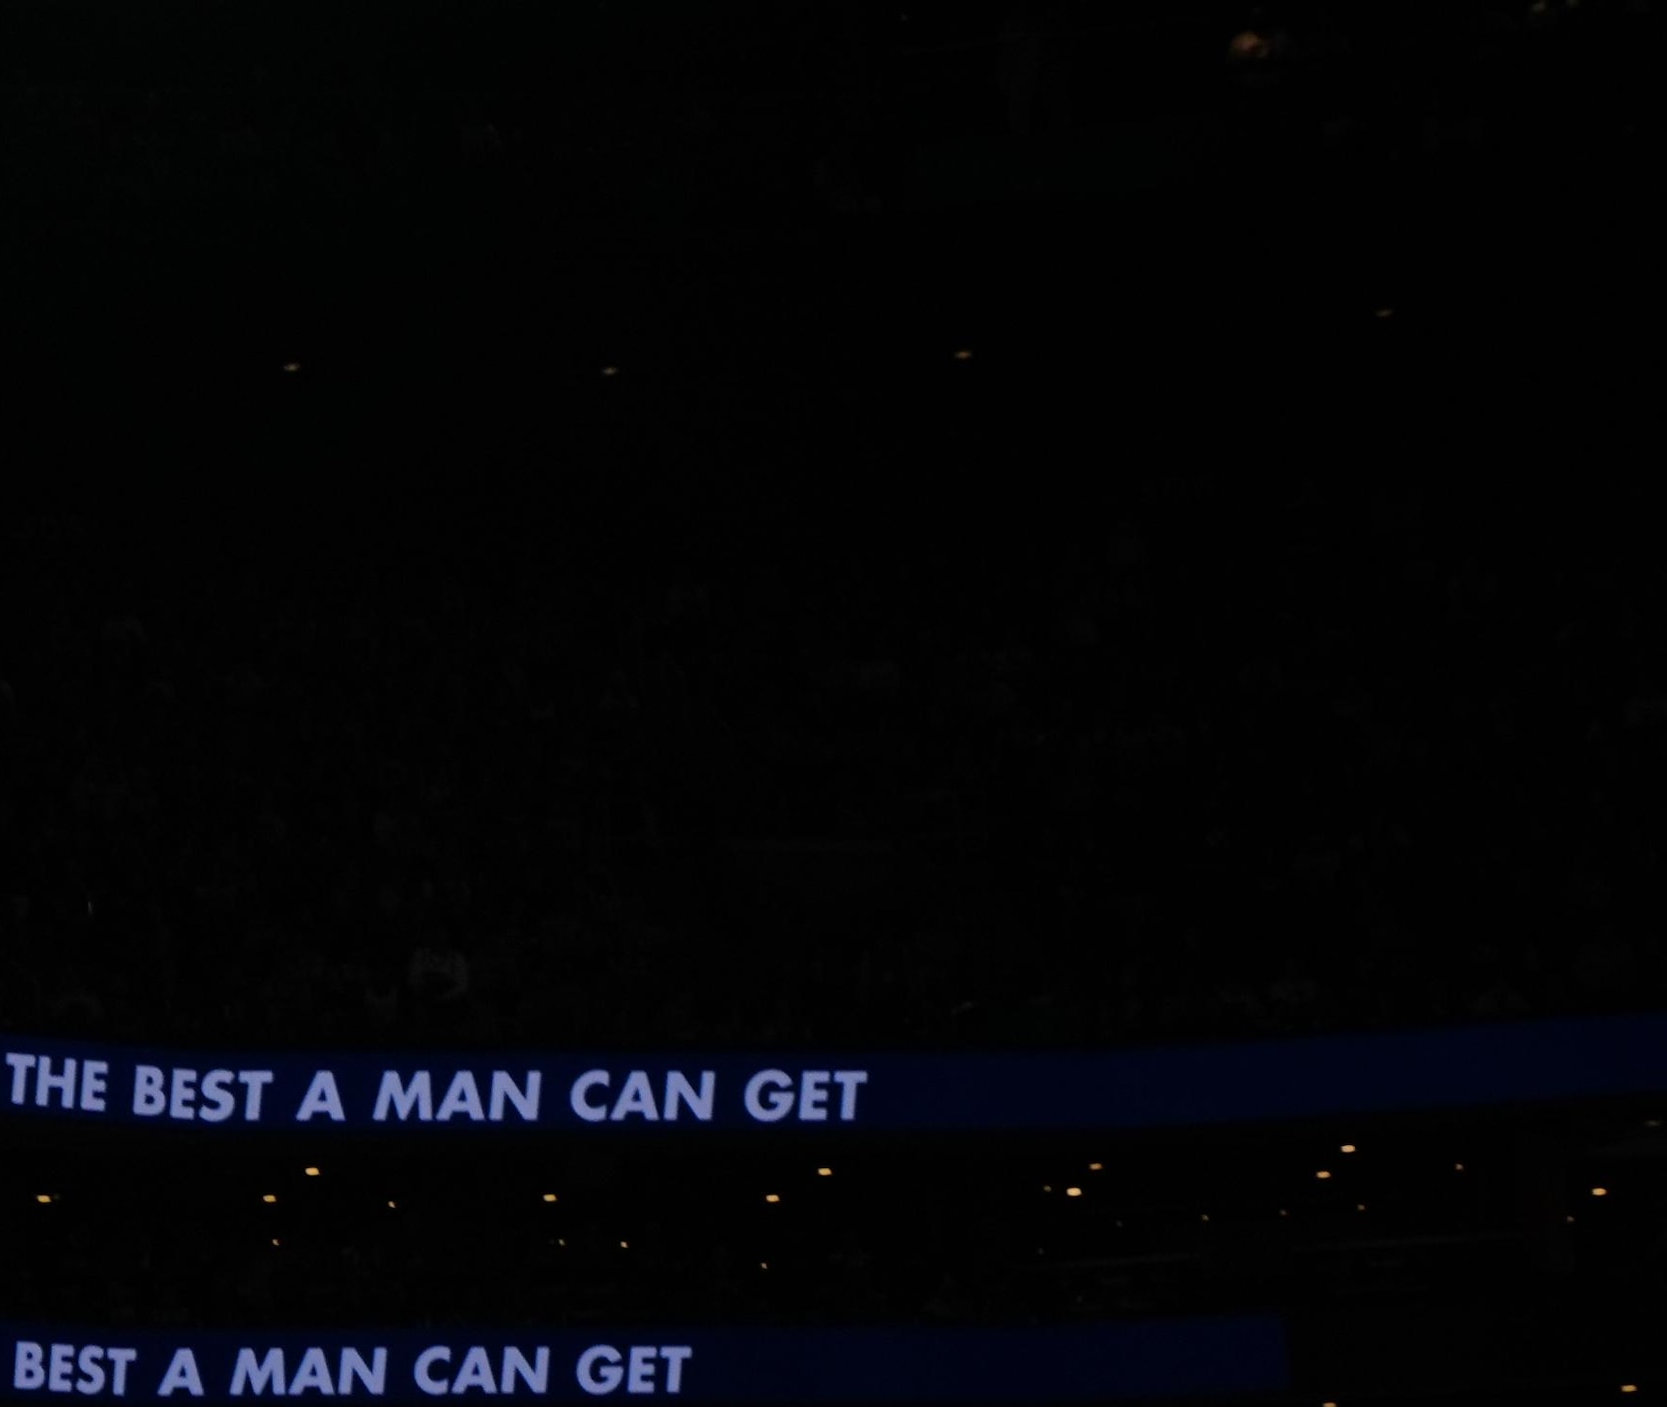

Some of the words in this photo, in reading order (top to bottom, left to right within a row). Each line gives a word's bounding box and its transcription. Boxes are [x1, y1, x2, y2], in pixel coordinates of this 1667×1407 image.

[7, 1053, 108, 1111] THE
[133, 1066, 273, 1122] BEST
[297, 1071, 345, 1121] A
[374, 1071, 541, 1121] MAN
[571, 1070, 715, 1121] CAN
[745, 1070, 868, 1121] GET
[15, 1342, 136, 1395] BEST
[159, 1349, 203, 1395] A
[231, 1348, 387, 1395] MAN
[415, 1347, 549, 1395] CAN
[577, 1346, 691, 1394] GET
